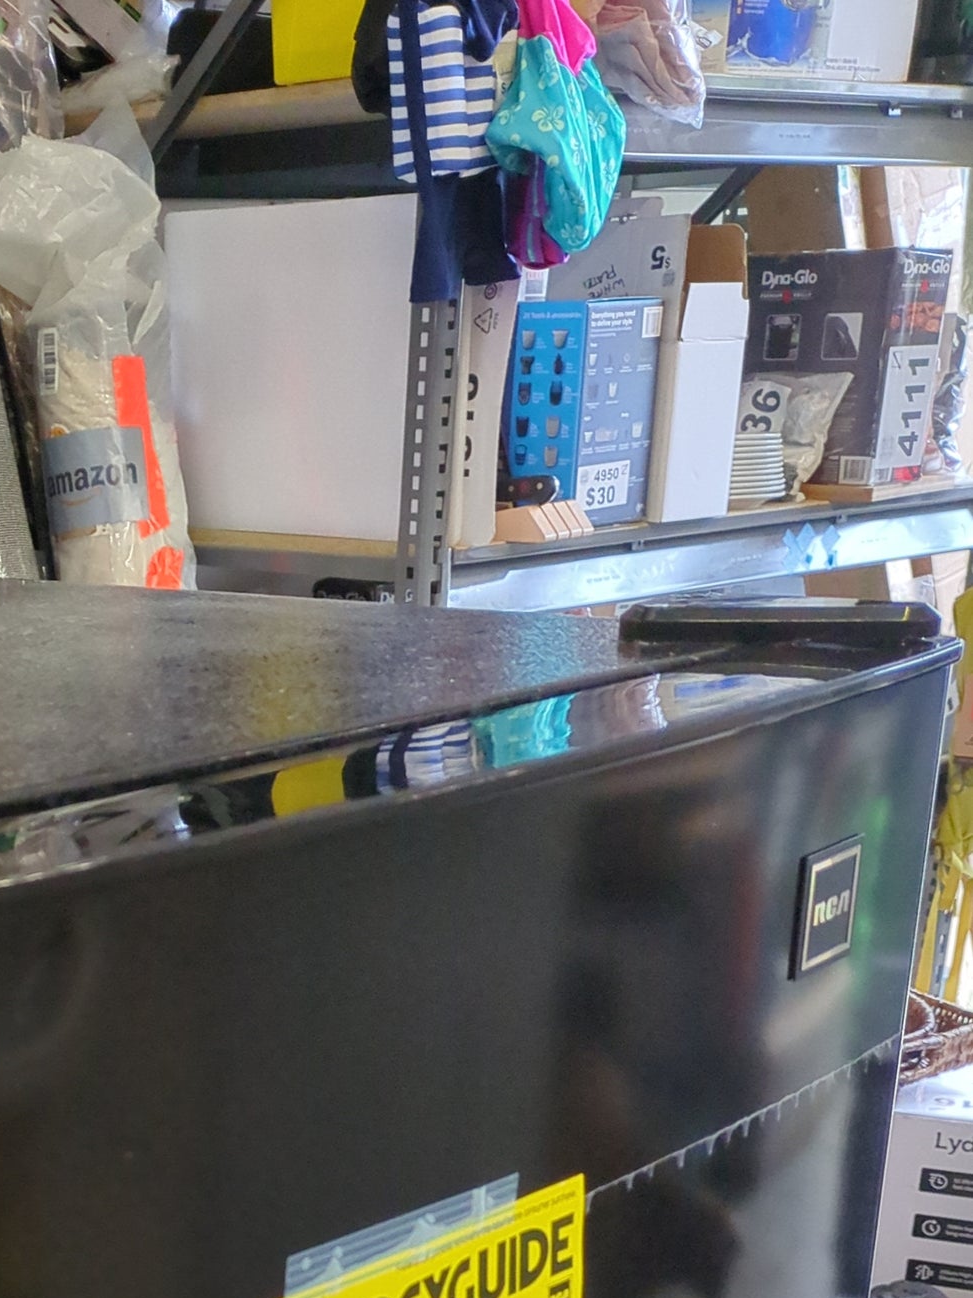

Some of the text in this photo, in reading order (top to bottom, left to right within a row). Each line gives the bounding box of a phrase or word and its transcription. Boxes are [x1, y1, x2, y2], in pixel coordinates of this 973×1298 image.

[651, 245, 671, 270] $5
[904, 258, 950, 278] Dyna-Glo
[761, 268, 818, 289] Dyna-Glo
[591, 311, 615, 320] Everything
[897, 358, 930, 457] 4111
[48, 462, 138, 498] amazon
[594, 467, 620, 482] 4950
[585, 485, 616, 507] $30
[813, 889, 850, 926] RCA
